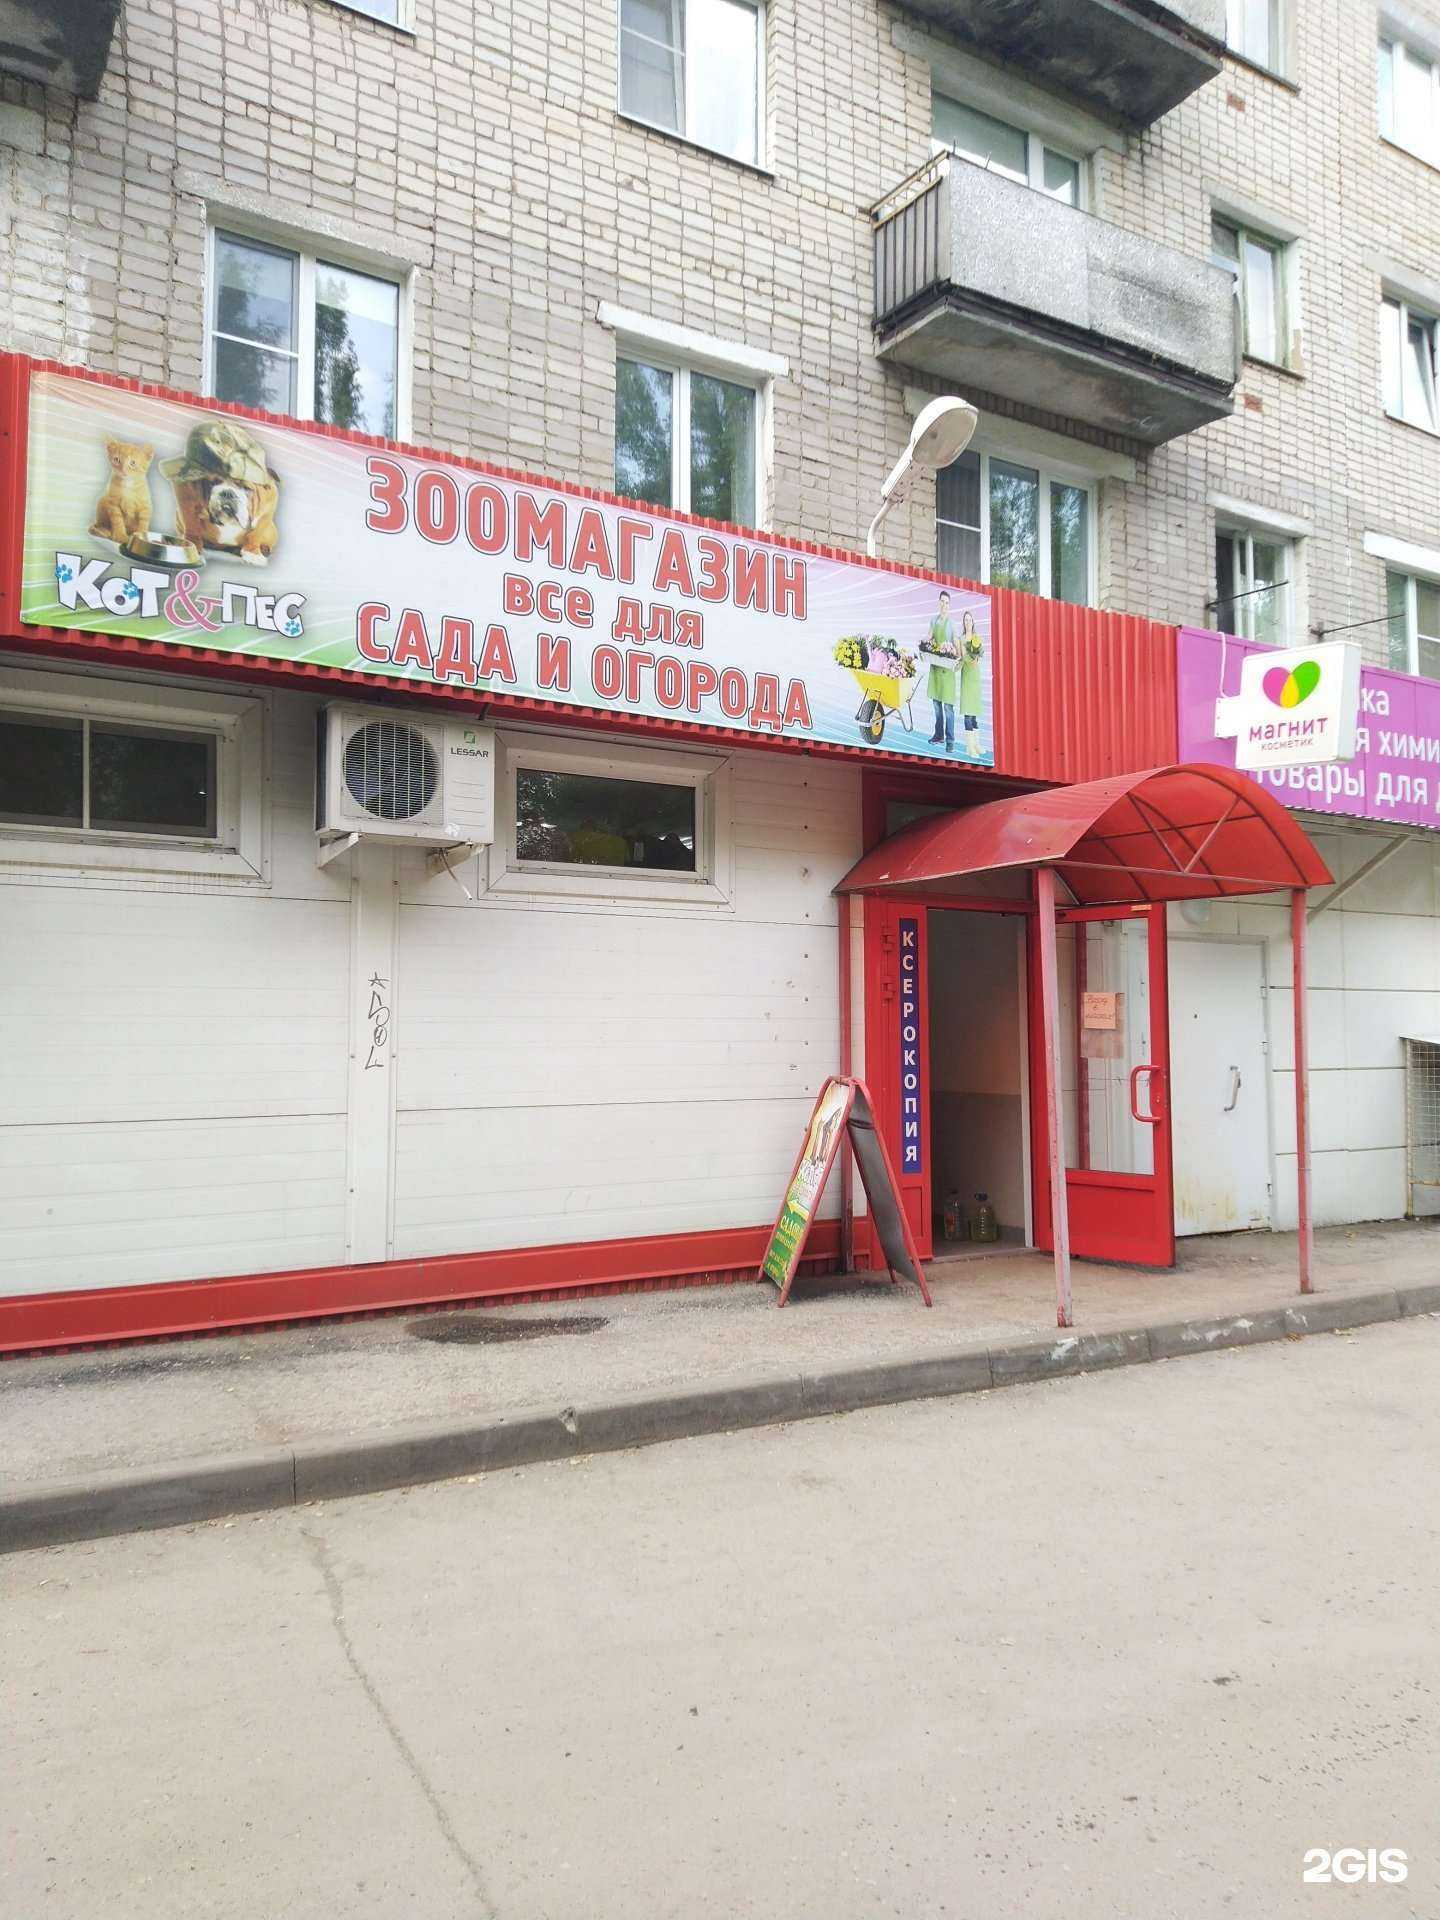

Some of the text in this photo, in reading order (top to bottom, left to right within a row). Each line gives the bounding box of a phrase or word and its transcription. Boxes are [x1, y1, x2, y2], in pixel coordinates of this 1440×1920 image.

[366, 455, 809, 622] ЗООМАГАЗИН
[503, 572, 704, 650] все для
[356, 601, 814, 733] САДА И ОГОРОДА
[450, 747, 489, 757] LESSAR
[1375, 771, 1428, 808] для
[901, 930, 919, 1163] КСЕРОКОПИЯ
